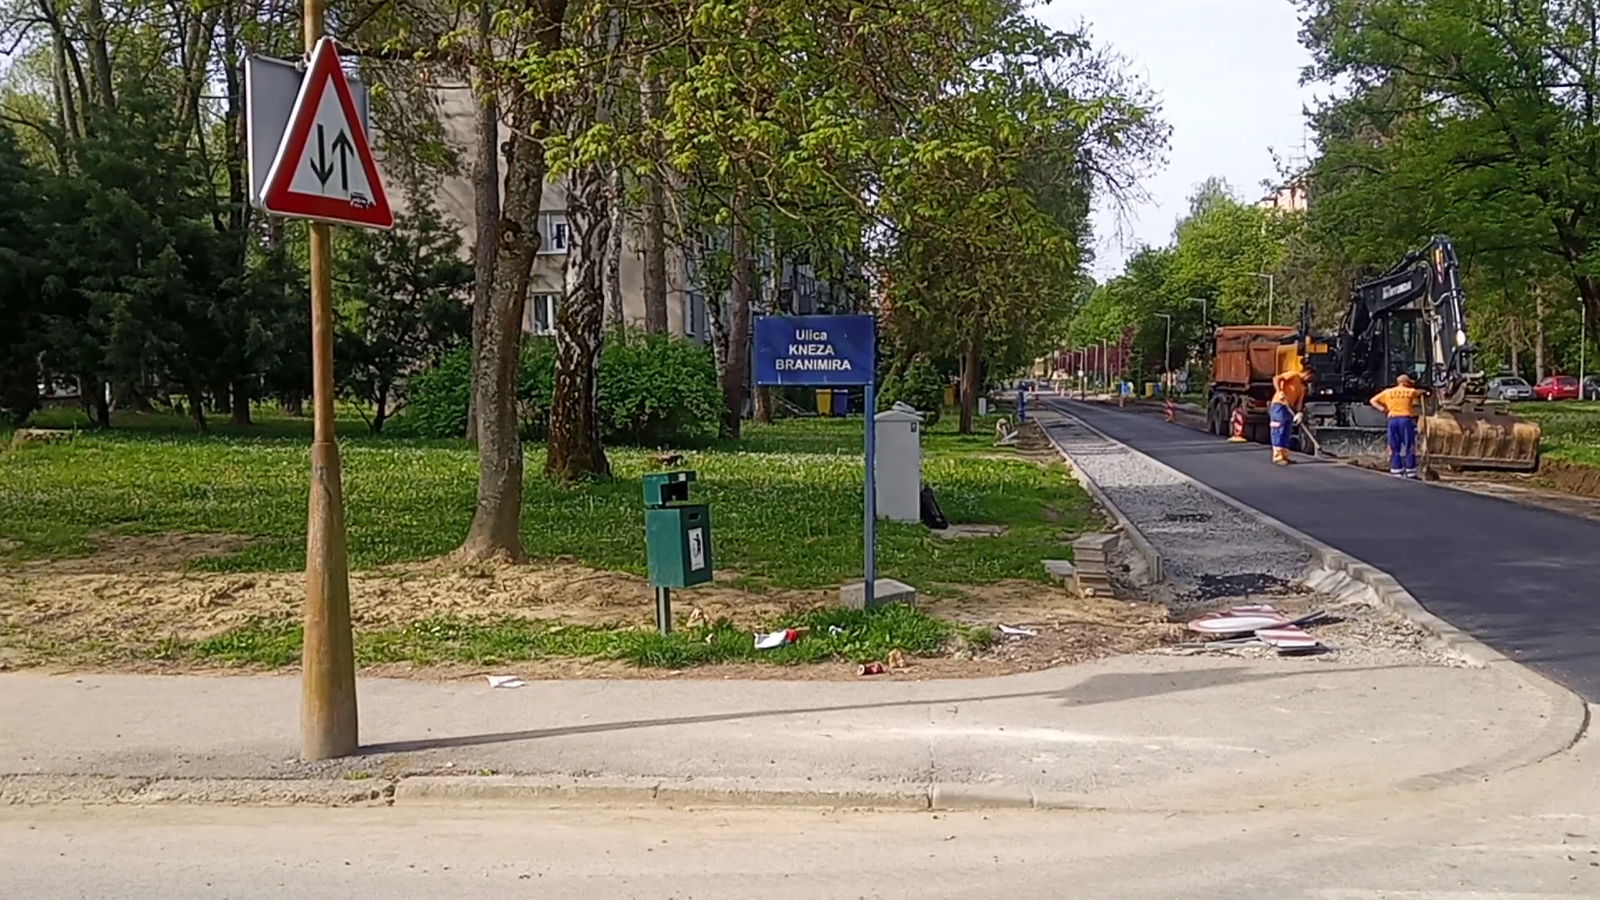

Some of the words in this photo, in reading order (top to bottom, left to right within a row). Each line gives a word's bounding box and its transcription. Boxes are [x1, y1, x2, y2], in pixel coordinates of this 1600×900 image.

[796, 329, 827, 340] Ulica
[789, 344, 835, 355] KNEZA
[775, 359, 851, 370] BRANIMIRA
